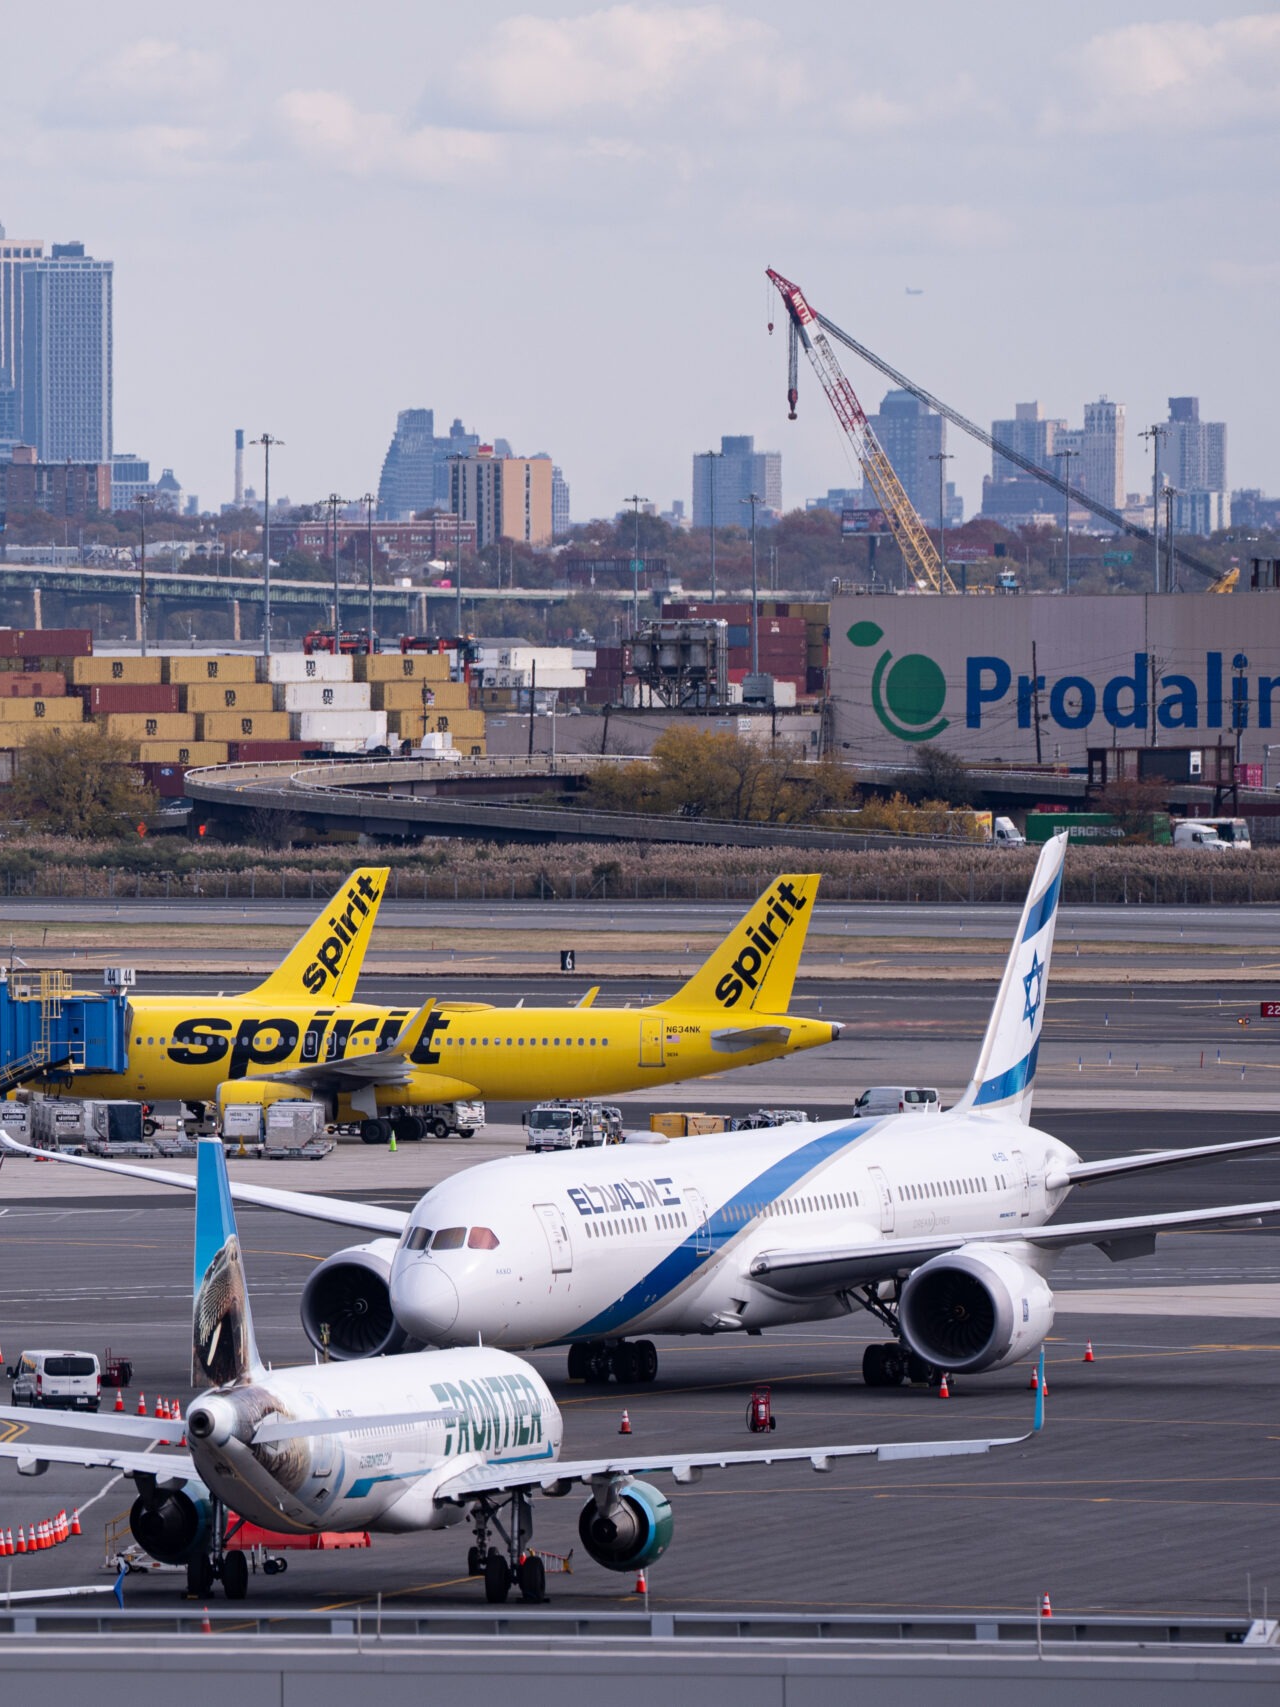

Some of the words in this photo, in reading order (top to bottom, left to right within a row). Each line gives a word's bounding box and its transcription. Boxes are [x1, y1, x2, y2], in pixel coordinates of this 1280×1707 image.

[303, 876, 380, 995] spirit
[716, 882, 807, 1008] spirit
[108, 969, 115, 985] 44
[124, 969, 132, 985] 44
[565, 951, 572, 969] 6
[167, 1010, 450, 1079] spirit
[666, 1026, 701, 1034] N634NK
[430, 1374, 542, 1456] FRONTIER
